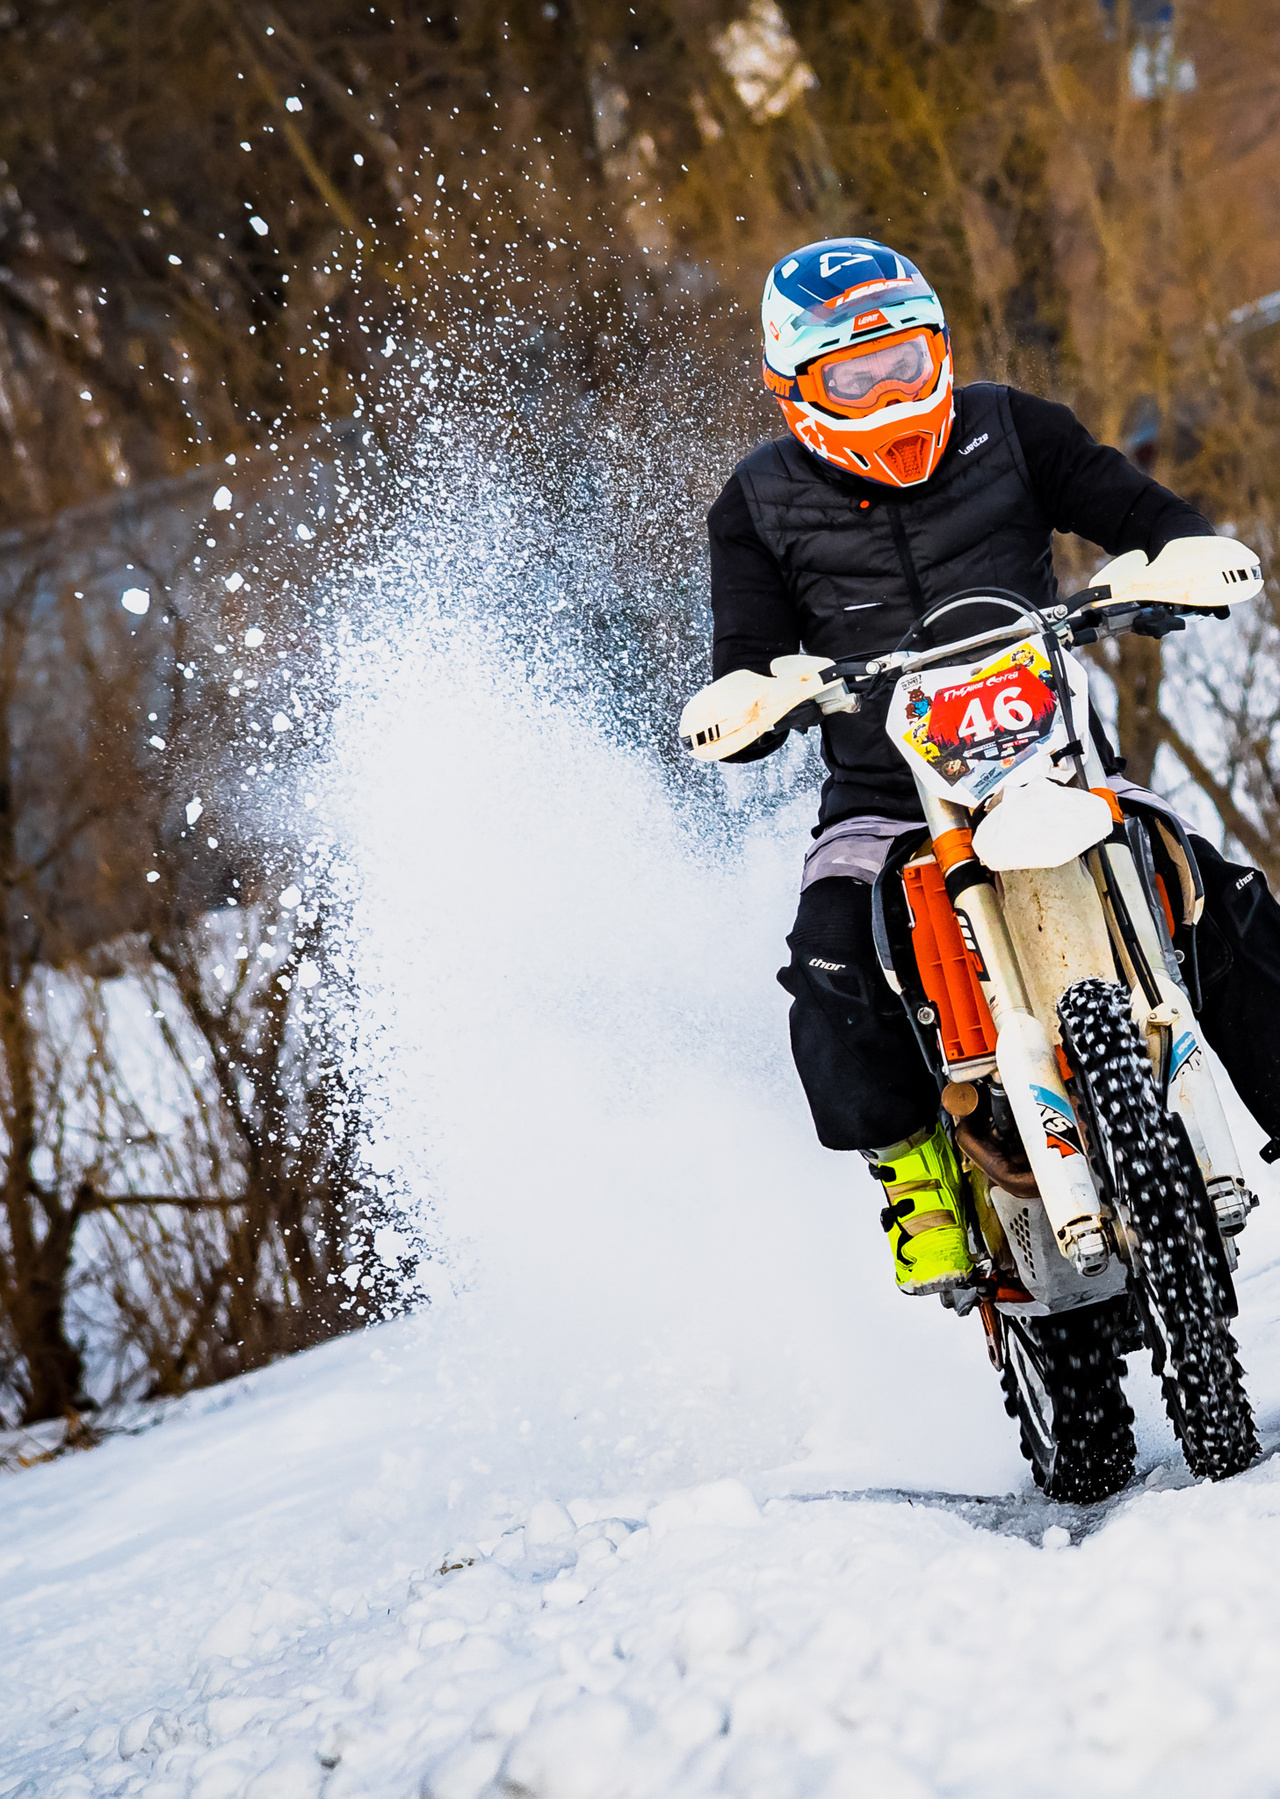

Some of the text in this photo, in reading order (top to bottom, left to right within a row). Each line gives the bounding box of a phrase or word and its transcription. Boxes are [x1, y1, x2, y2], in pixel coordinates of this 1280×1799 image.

[858, 313, 880, 326] LEATT
[958, 686, 1033, 742] 46
[1235, 870, 1255, 891] thor
[808, 957, 847, 972] thor
